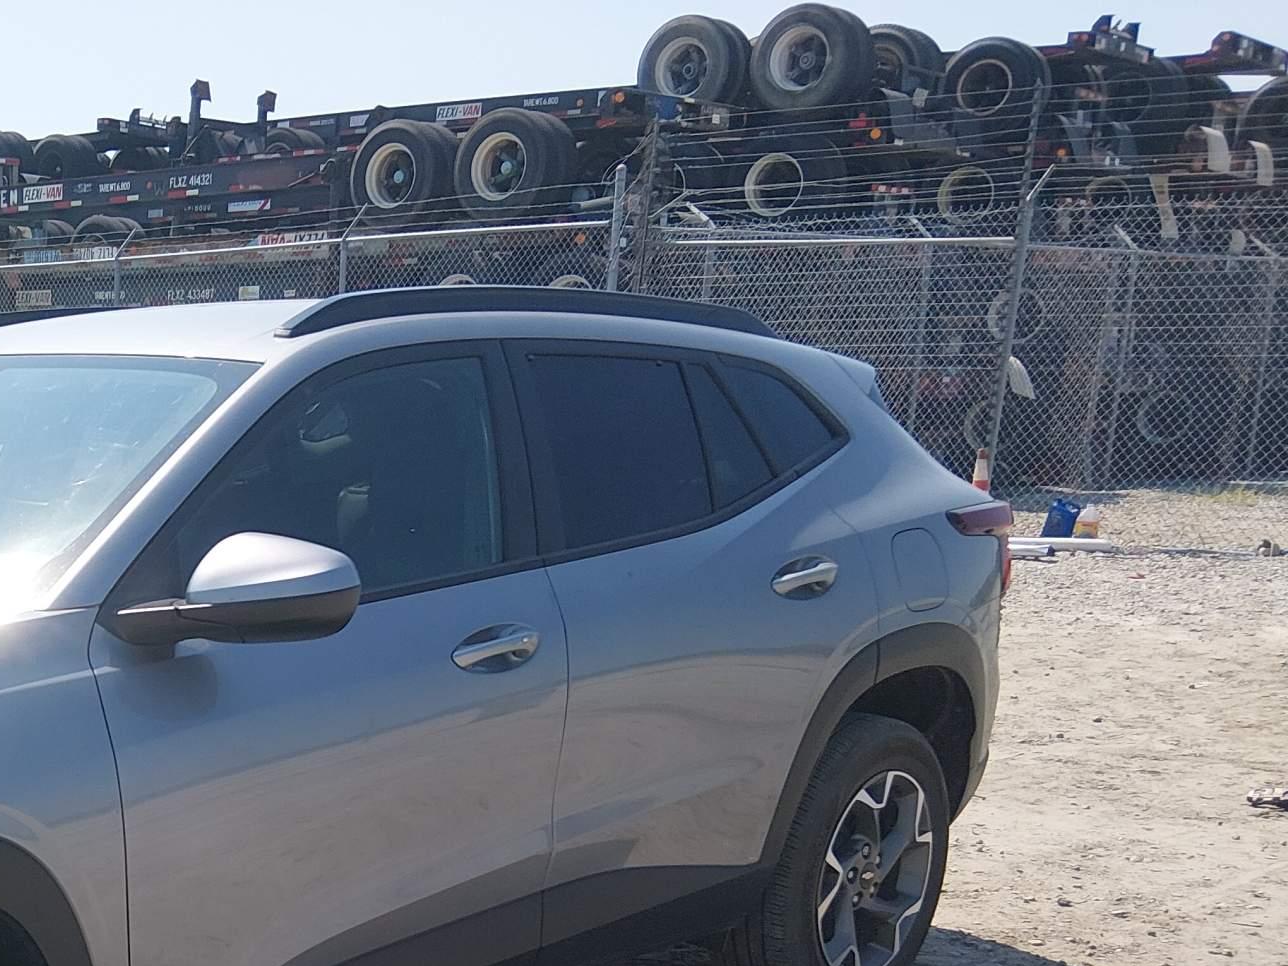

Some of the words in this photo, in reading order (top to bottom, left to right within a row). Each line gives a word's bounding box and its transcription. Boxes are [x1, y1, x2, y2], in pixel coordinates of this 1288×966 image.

[437, 105, 481, 119] FLEXI-VAN
[169, 176, 187, 188] FLXZ
[188, 173, 213, 187] 414321
[24, 187, 63, 201] FLEXI-VAN
